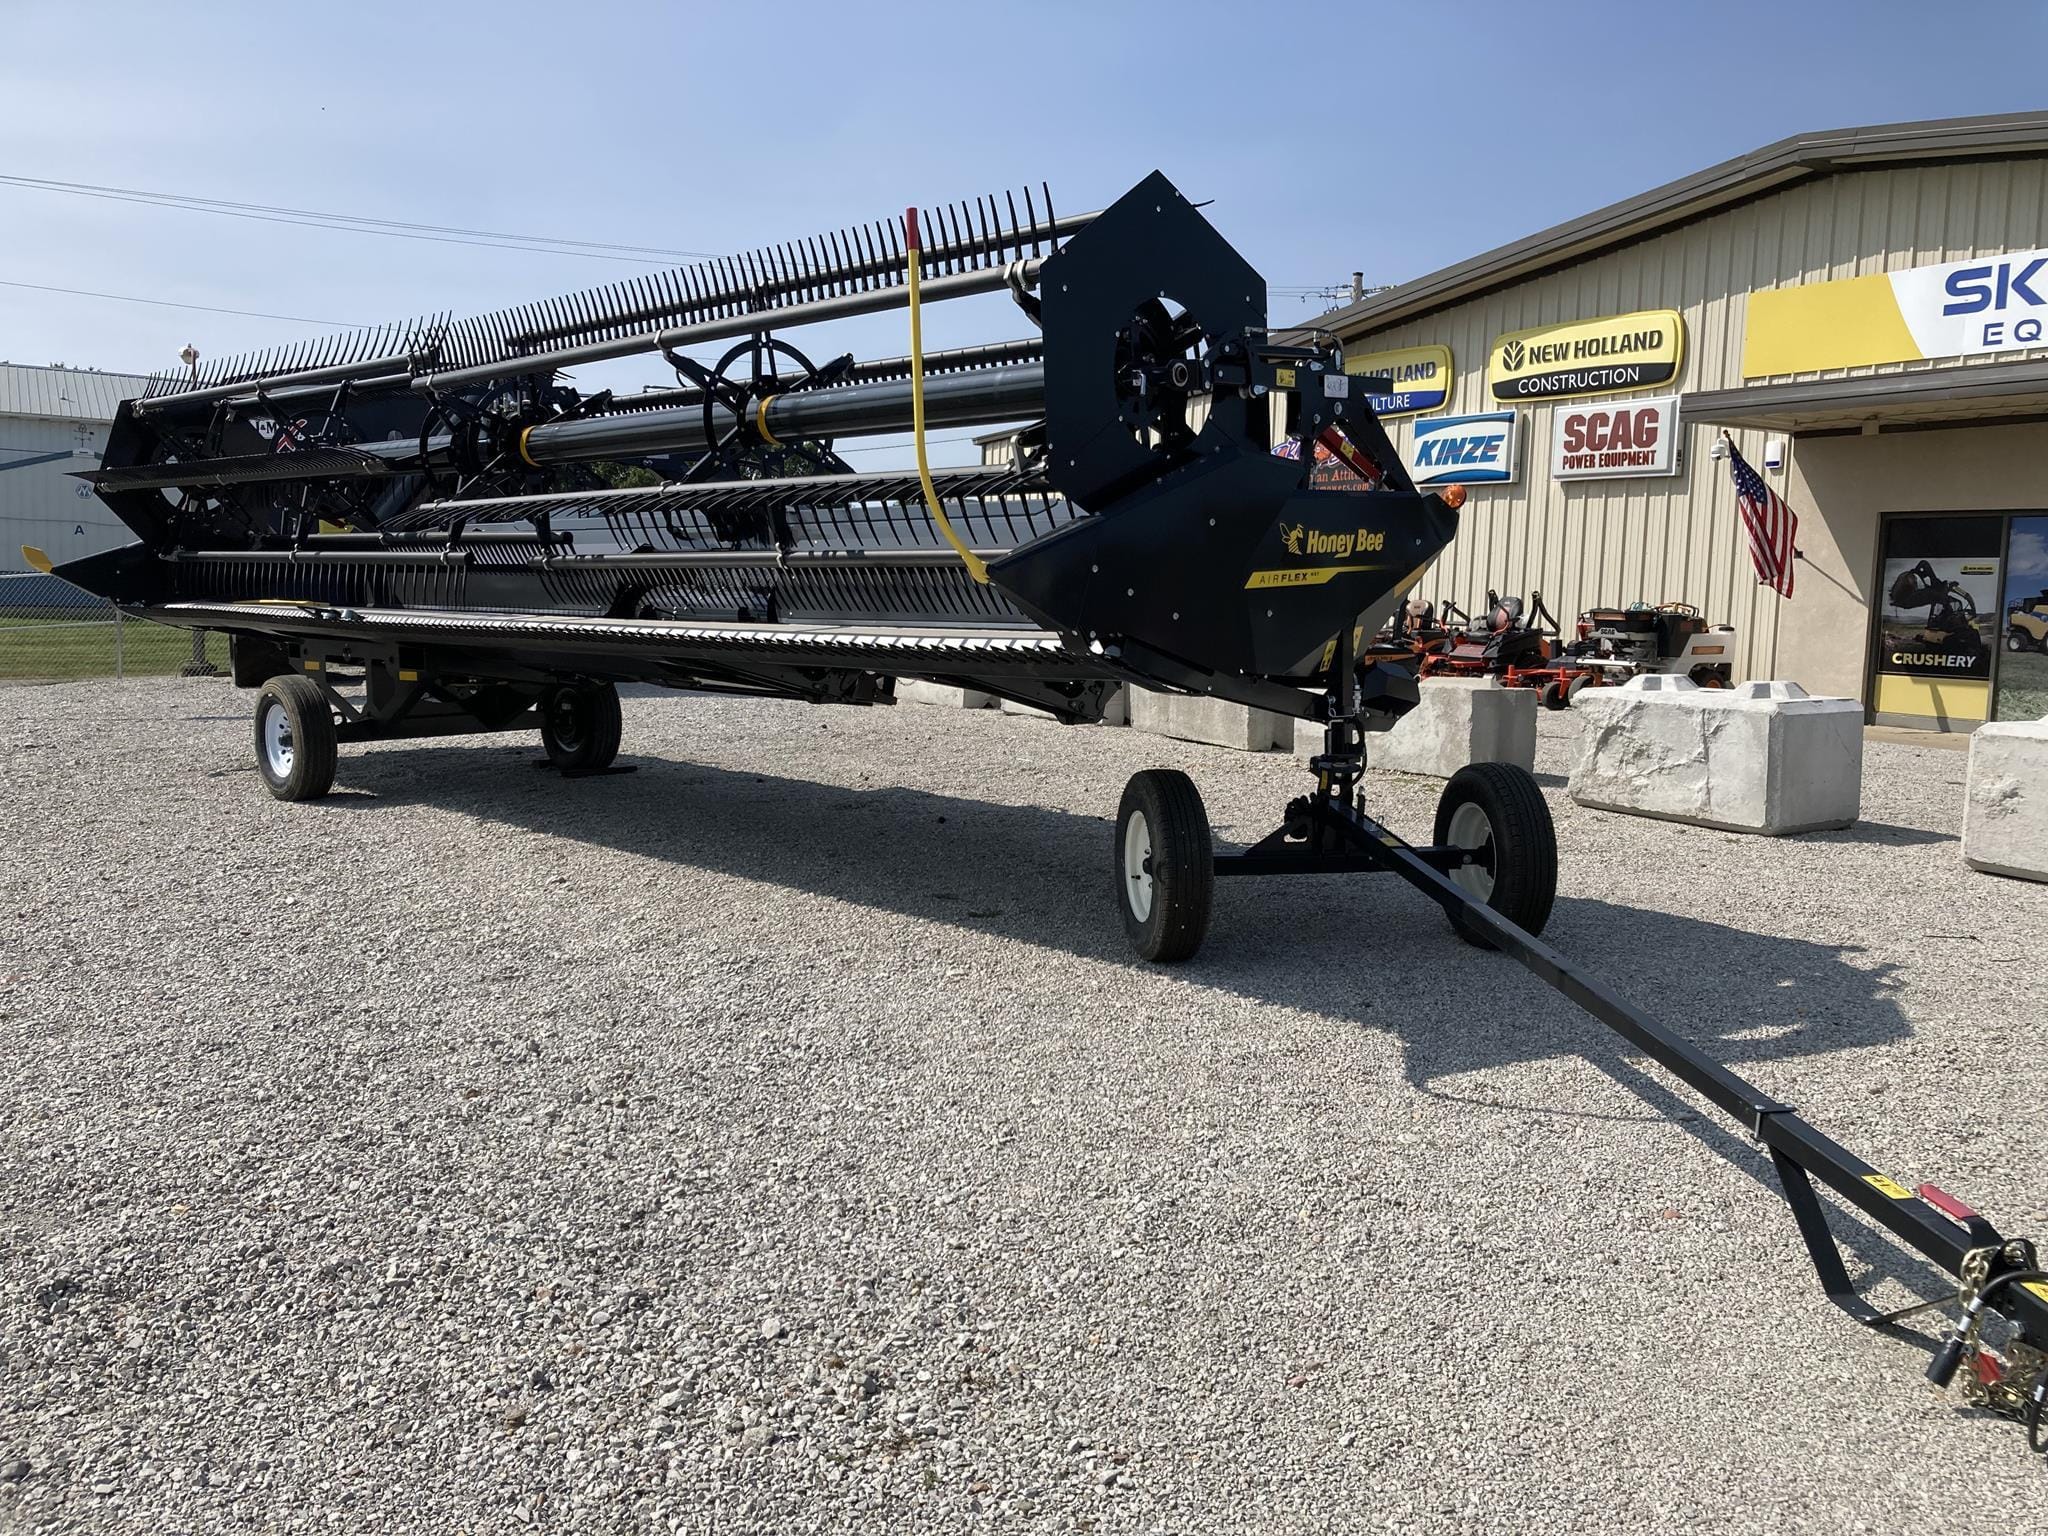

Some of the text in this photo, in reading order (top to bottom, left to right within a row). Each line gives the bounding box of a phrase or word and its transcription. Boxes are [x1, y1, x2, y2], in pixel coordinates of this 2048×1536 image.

[1528, 329, 1663, 366] NEW HOLLAND
[1518, 366, 1639, 394] CONSTRUCTION
[1563, 407, 1659, 453] SCAG
[1414, 434, 1506, 467] KINZE
[1562, 452, 1596, 470] POWER
[1598, 449, 1657, 468] EQUIPMENT
[1306, 528, 1385, 559] Honey Bee
[1258, 572, 1309, 585] AIRFLEX
[1891, 652, 1977, 668] CRUSHERY
